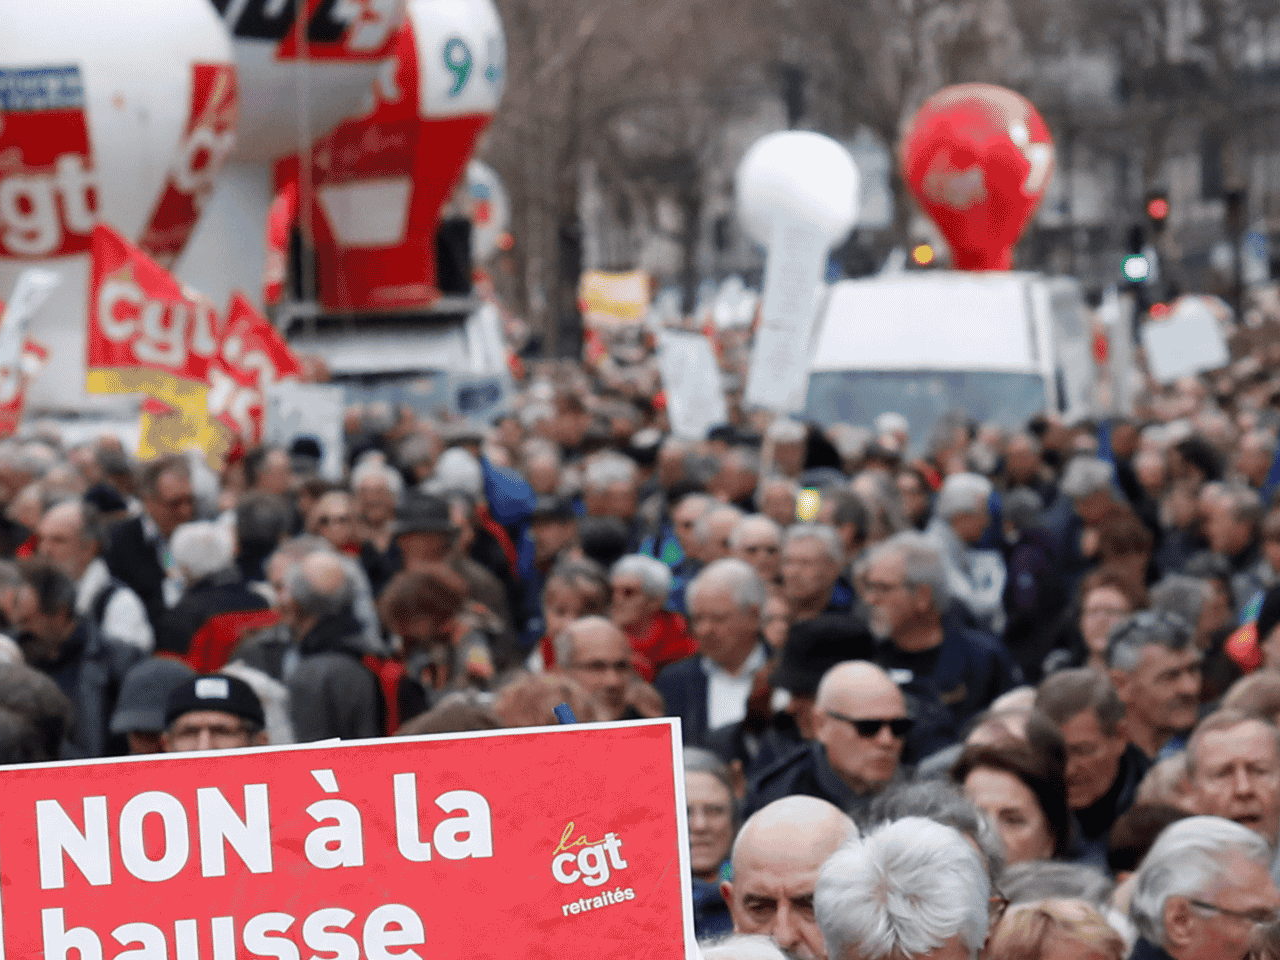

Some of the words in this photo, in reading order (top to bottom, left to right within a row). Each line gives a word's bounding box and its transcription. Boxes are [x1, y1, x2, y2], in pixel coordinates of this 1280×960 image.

[98, 279, 220, 366] cgt
[35, 783, 274, 889] NON
[304, 769, 365, 869] à
[393, 772, 494, 862] la
[552, 821, 618, 855] la
[552, 832, 628, 887] cgt
[561, 887, 635, 917] retraités
